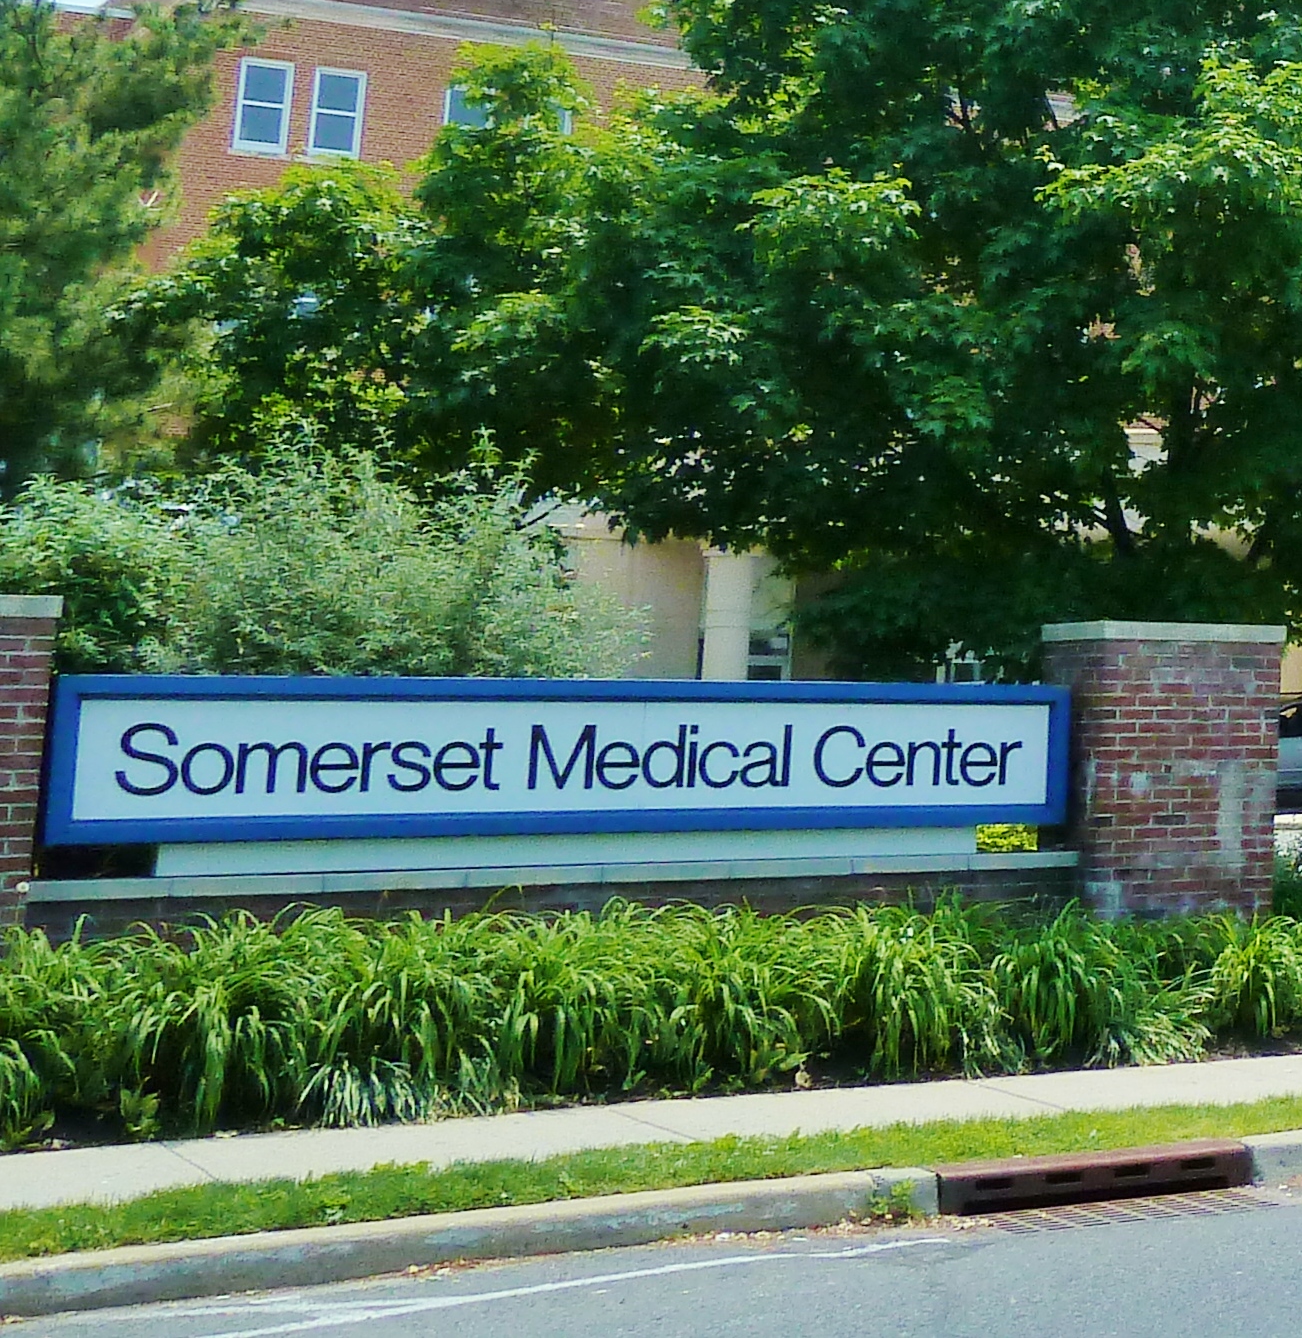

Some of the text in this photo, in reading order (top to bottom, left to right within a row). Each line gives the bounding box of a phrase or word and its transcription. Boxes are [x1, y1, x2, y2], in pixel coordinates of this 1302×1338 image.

[112, 722, 1022, 796] Somerset Medical Center
